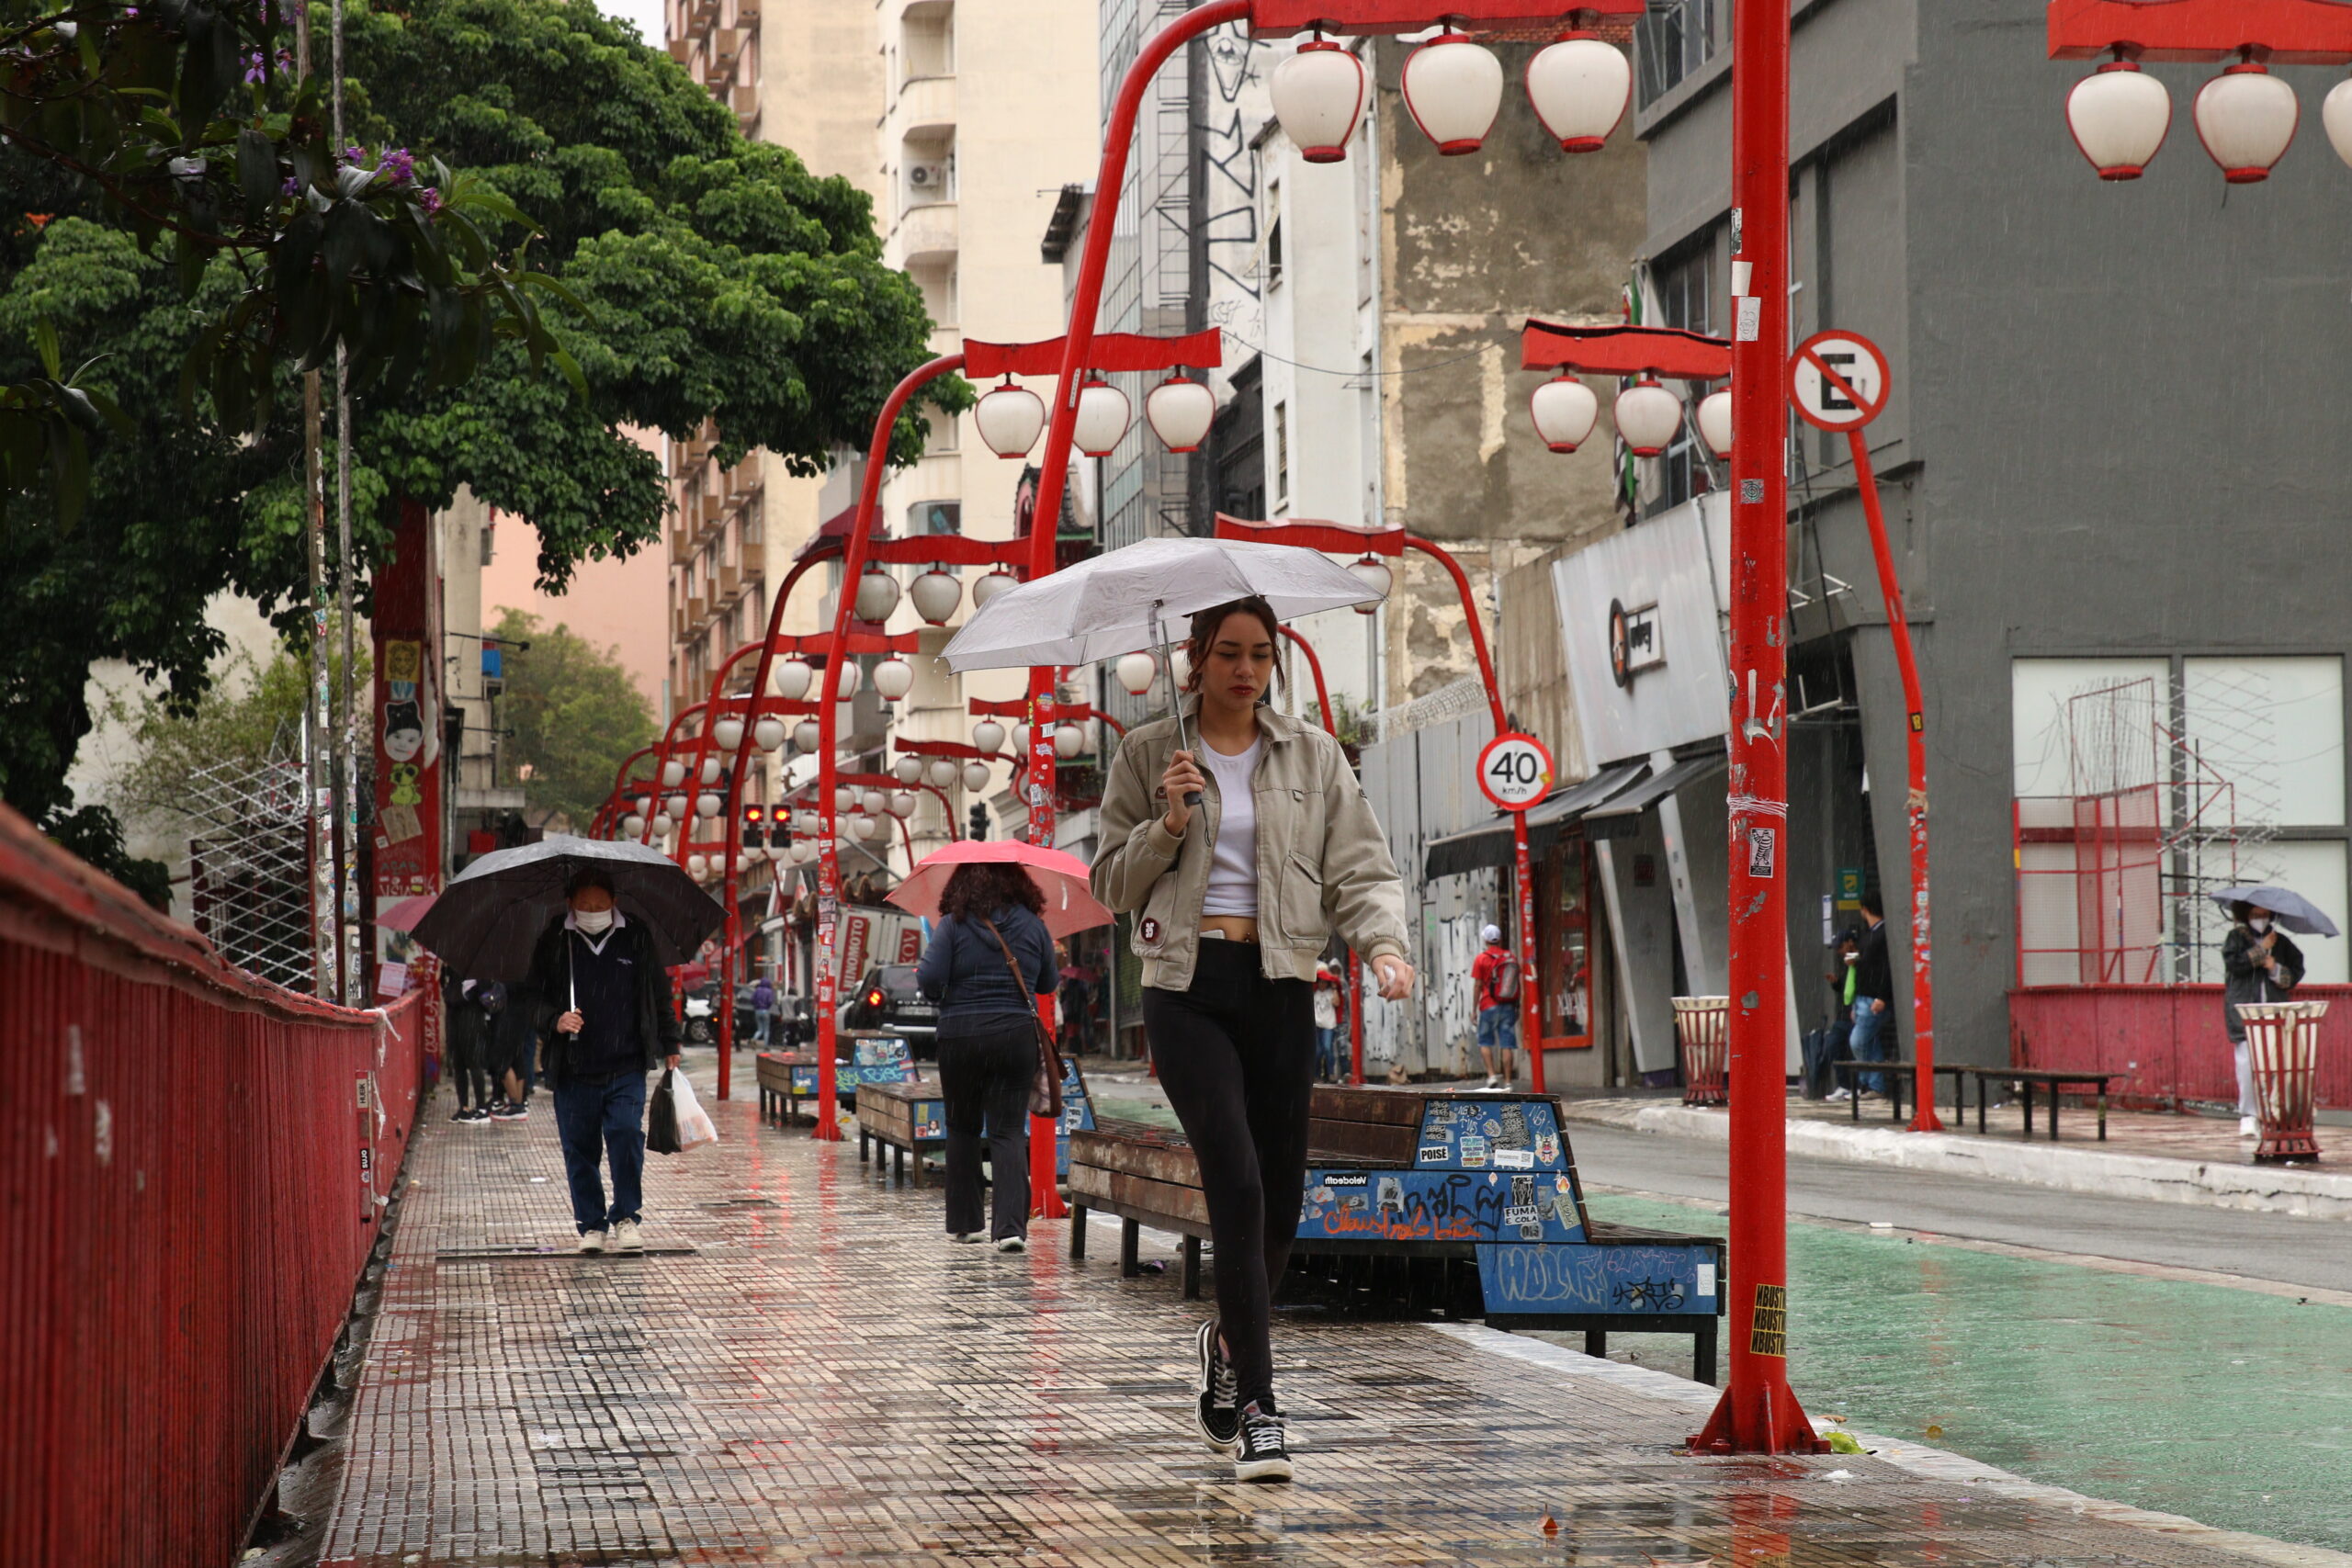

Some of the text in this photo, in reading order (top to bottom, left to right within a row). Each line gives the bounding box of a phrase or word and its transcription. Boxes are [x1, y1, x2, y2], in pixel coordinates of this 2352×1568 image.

[1820, 354, 1856, 410] E
[1490, 751, 1537, 784] 40
[1502, 786, 1527, 795] km/h
[1421, 1147, 1447, 1160] POISÉ
[1505, 1207, 1537, 1217] FUMA
[1515, 1215, 1537, 1224] COLA
